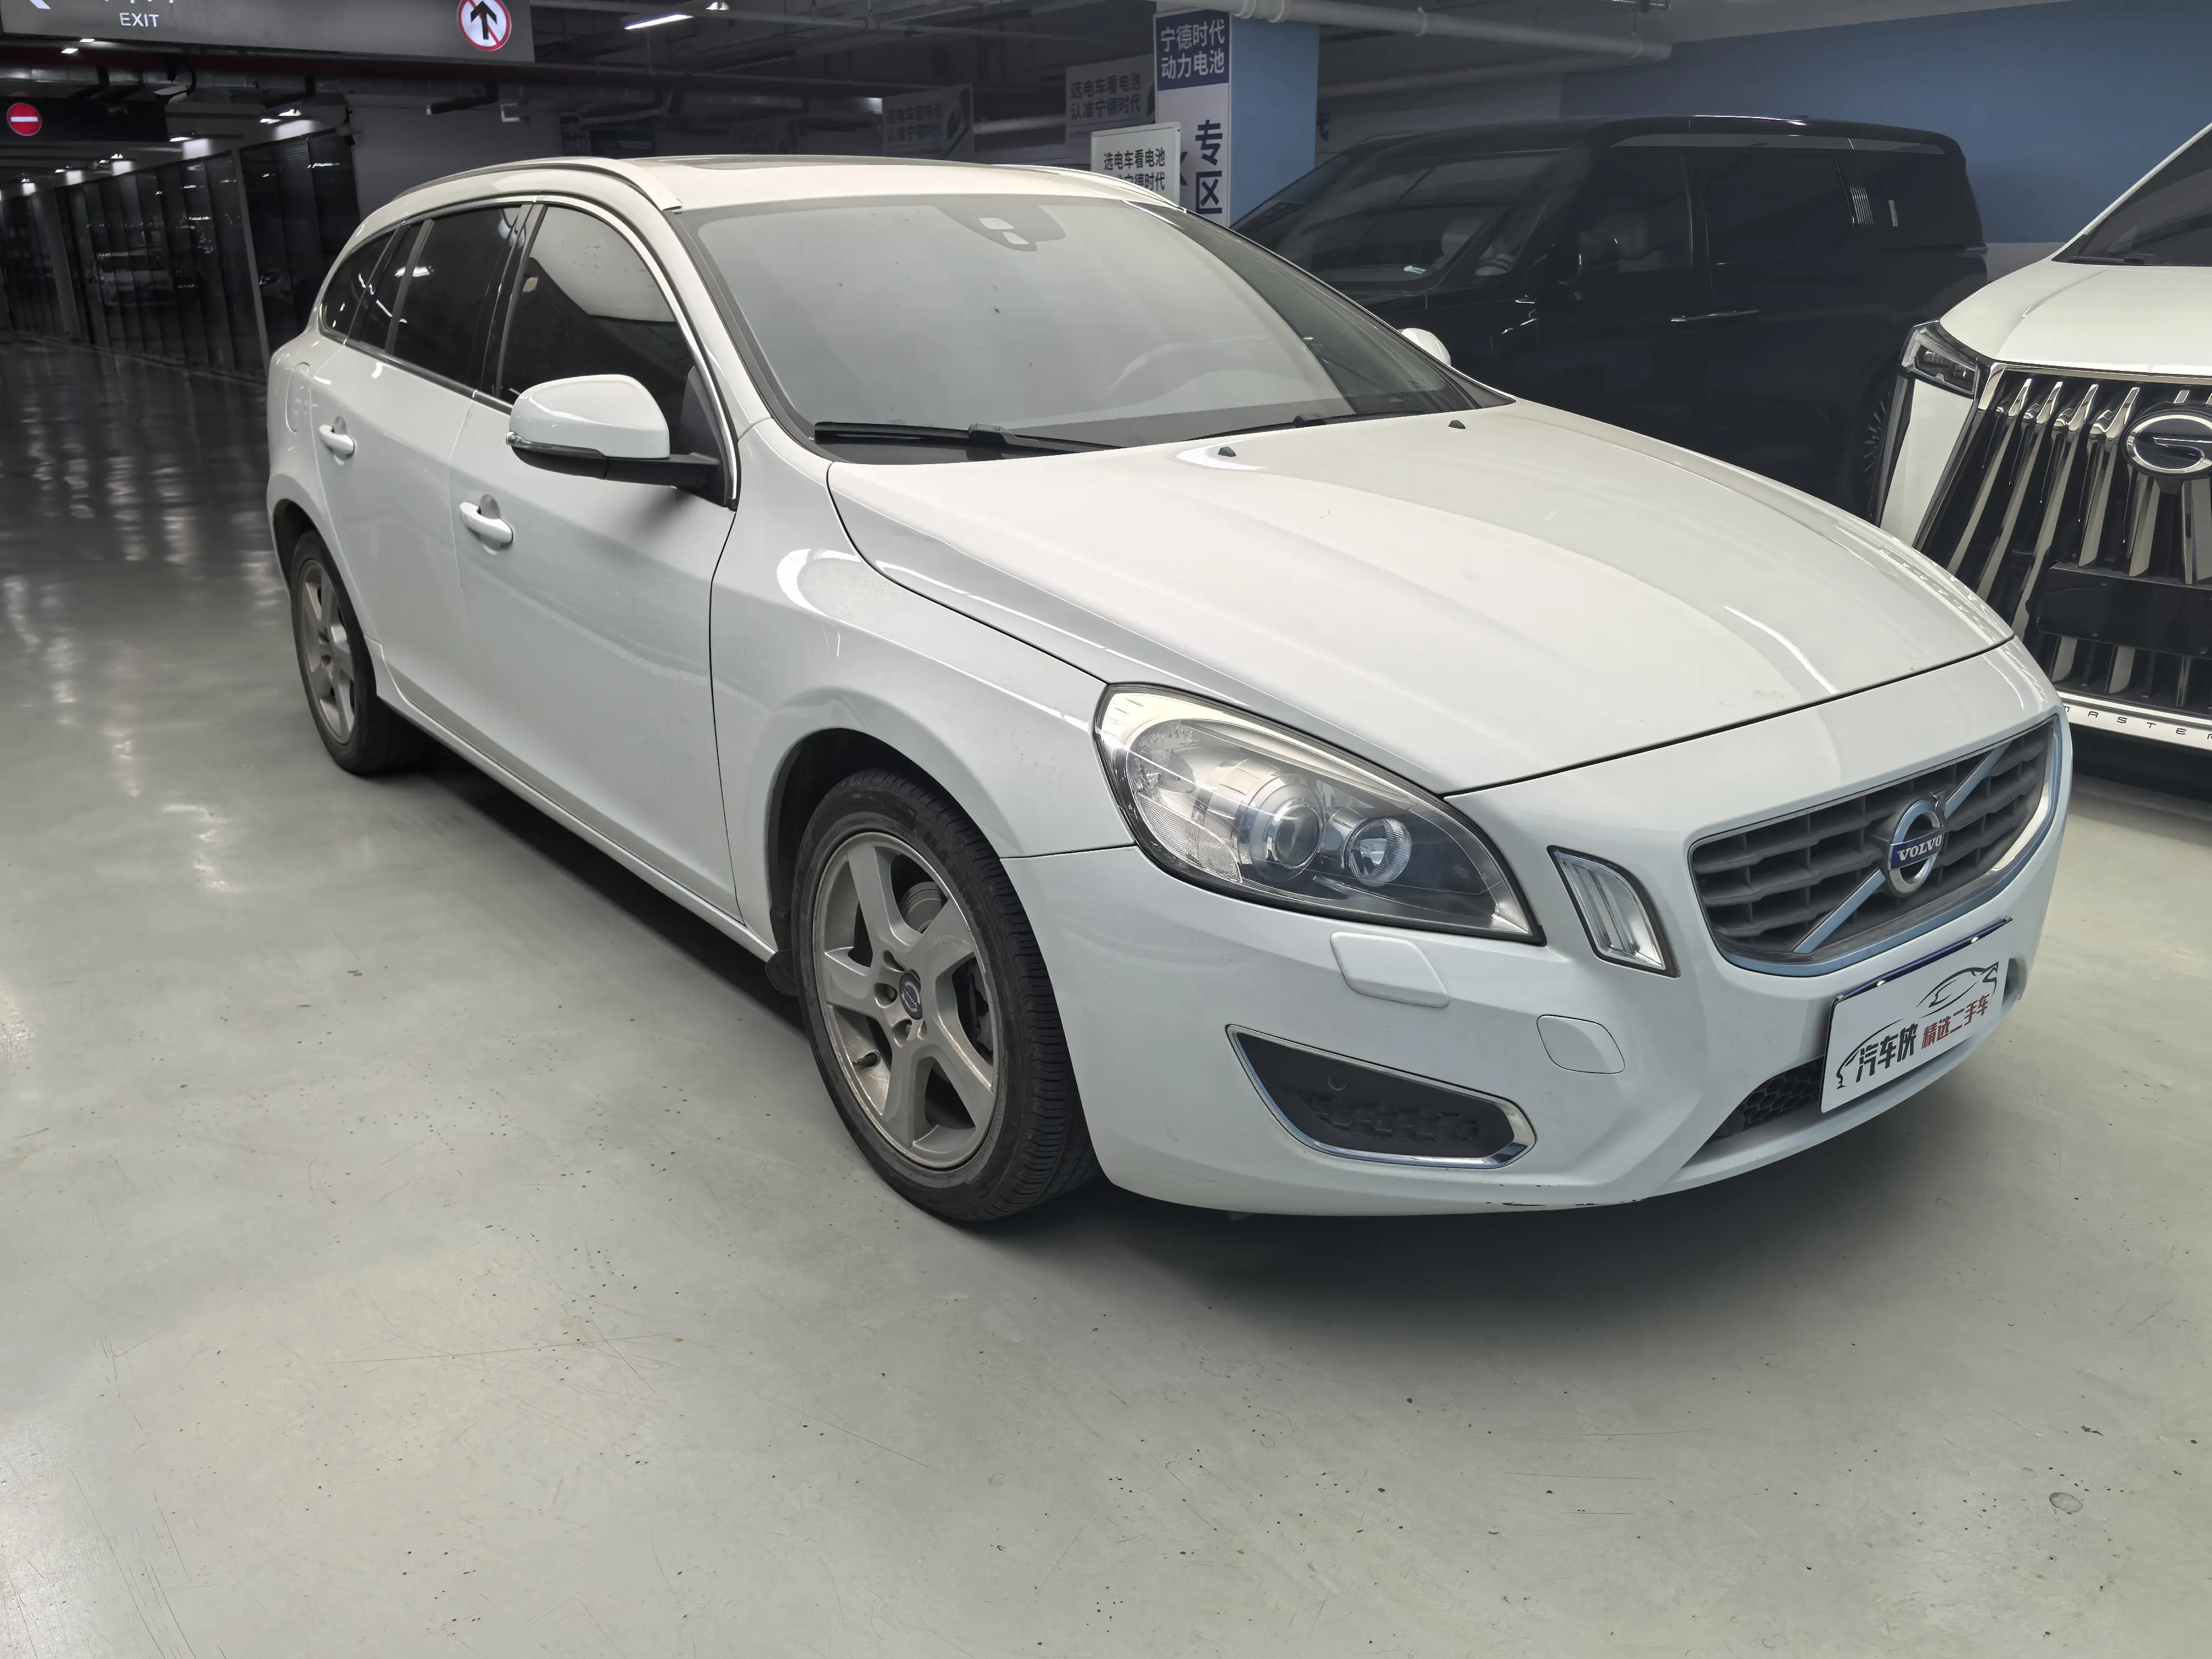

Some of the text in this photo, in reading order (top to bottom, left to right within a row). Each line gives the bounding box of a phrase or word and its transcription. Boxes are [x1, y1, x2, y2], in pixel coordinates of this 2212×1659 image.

[119, 12, 159, 28] EXIT
[1161, 19, 1225, 52] 宁德时代
[1161, 48, 1225, 79] 动力电池
[1104, 147, 1165, 171] 选电车看电池
[1195, 119, 1223, 214] 专区
[1116, 171, 1165, 191] 宁德时代
[1897, 834, 1942, 861] VOLVO
[1856, 994, 1990, 1082] 汽车侠 精选二手车
